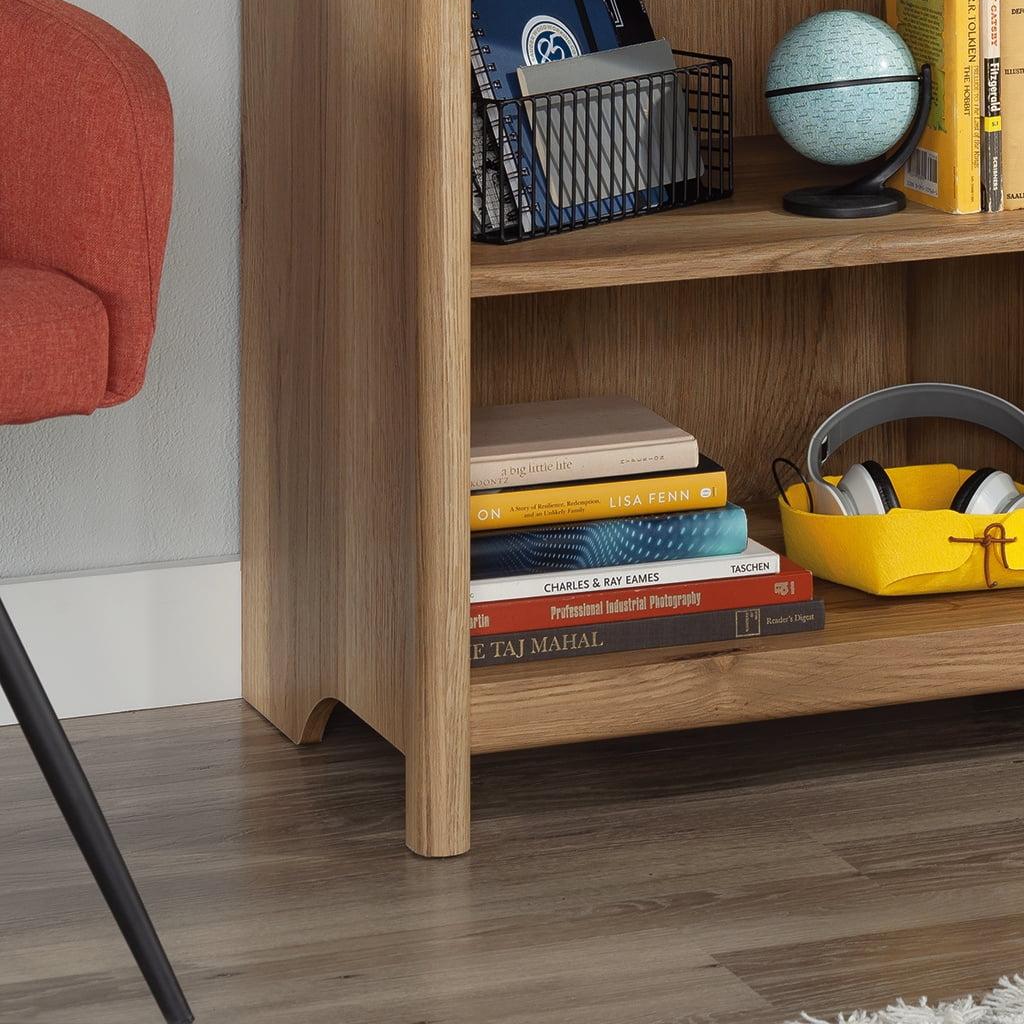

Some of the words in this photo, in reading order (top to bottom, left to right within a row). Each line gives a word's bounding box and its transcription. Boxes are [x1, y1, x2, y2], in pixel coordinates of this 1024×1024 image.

[968, 17, 976, 62] TOLKIEN
[988, 62, 1000, 112] Fitzgerald
[501, 468, 507, 476] a
[509, 465, 526, 478] big
[528, 462, 553, 473] little
[609, 495, 642, 508] LISA
[648, 489, 690, 504] FENN
[477, 508, 501, 521] ON
[515, 504, 530, 513] Story
[567, 506, 586, 516] Family
[731, 562, 770, 573] TASCHEN
[544, 579, 590, 593] CHARLES
[592, 578, 601, 588] &
[604, 576, 622, 586] RAY
[626, 573, 660, 585] EAMES
[551, 601, 603, 620] Professional
[606, 596, 647, 614] Industrial
[649, 591, 701, 609] Photography
[766, 614, 793, 625] Reader's
[795, 613, 815, 623] Digest
[491, 639, 525, 659] TAJ
[531, 631, 604, 654] MAHAL
